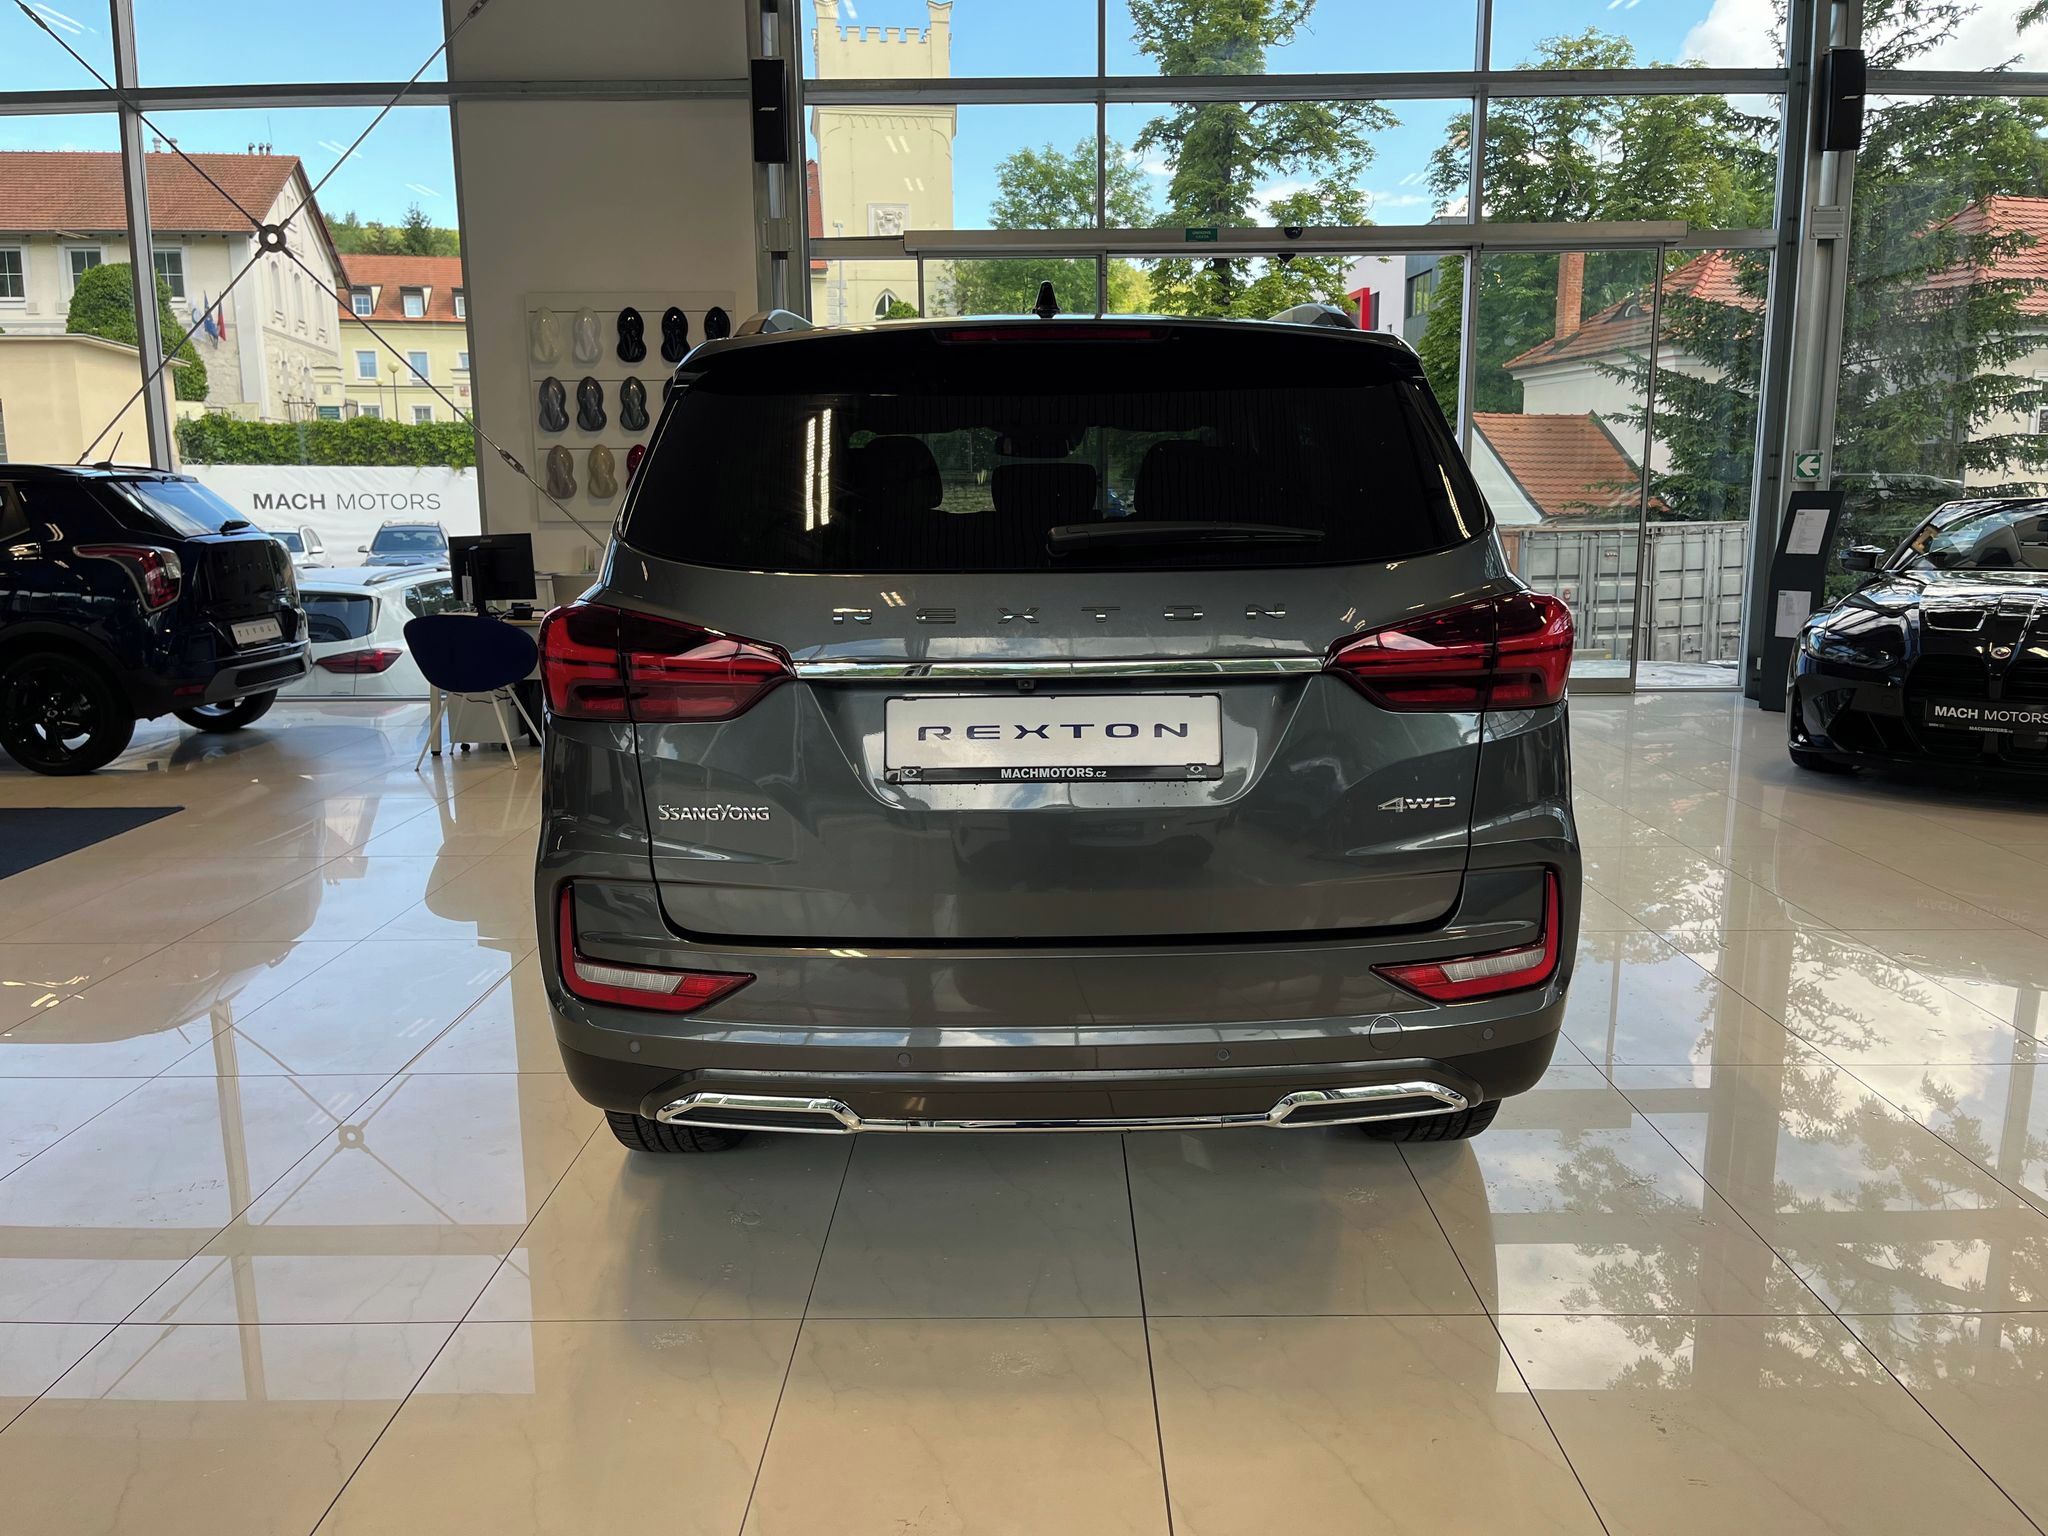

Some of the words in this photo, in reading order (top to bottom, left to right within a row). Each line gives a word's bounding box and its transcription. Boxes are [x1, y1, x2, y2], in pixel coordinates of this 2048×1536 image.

[252, 493, 326, 510] MACH
[336, 493, 441, 511] MOTORS
[832, 603, 1287, 625] REXTON
[1934, 705, 1979, 720] MACH
[917, 722, 1188, 741] REXTON
[1000, 766, 1107, 779] MACHMOTORS.cz
[1378, 796, 1456, 813] 4WD
